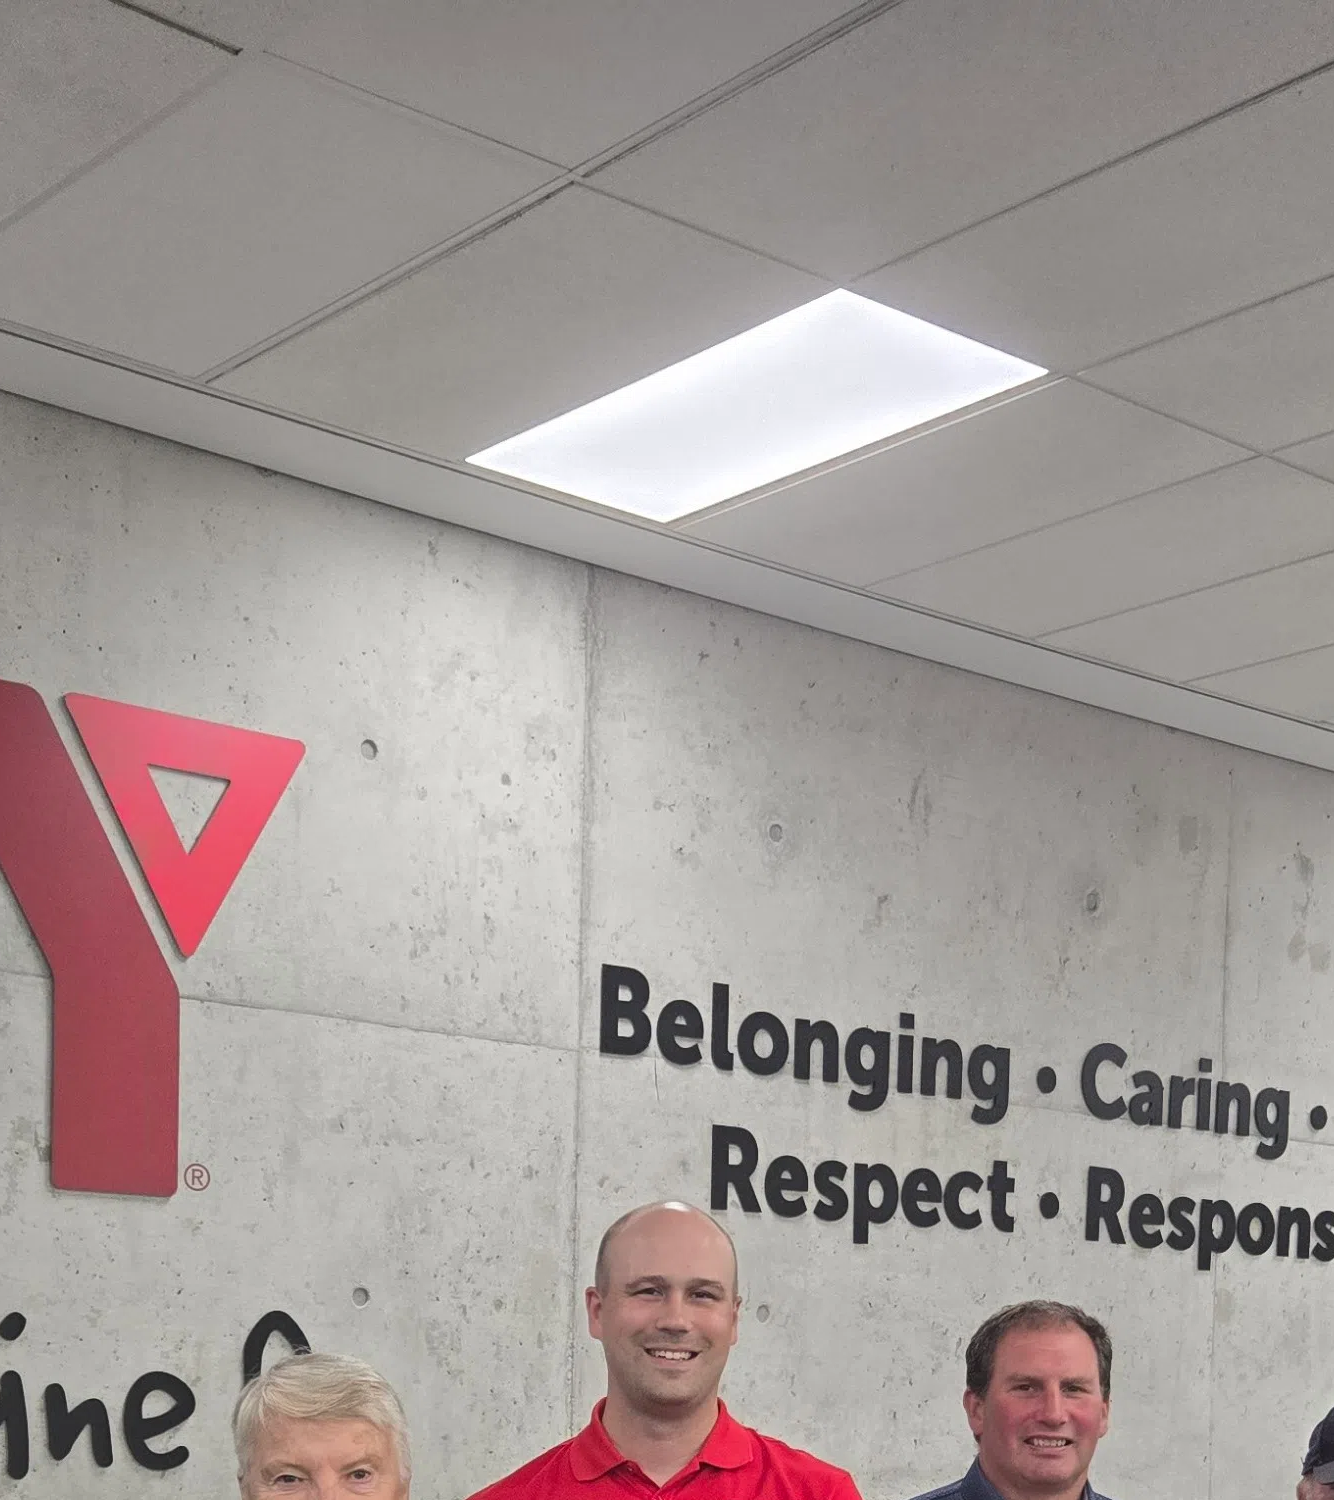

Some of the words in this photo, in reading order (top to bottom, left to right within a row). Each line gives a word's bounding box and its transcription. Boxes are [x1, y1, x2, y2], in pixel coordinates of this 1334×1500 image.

[599, 963, 1012, 1125] Belonging
[1080, 1042, 1291, 1160] Caring
[710, 1124, 1017, 1245] Respect
